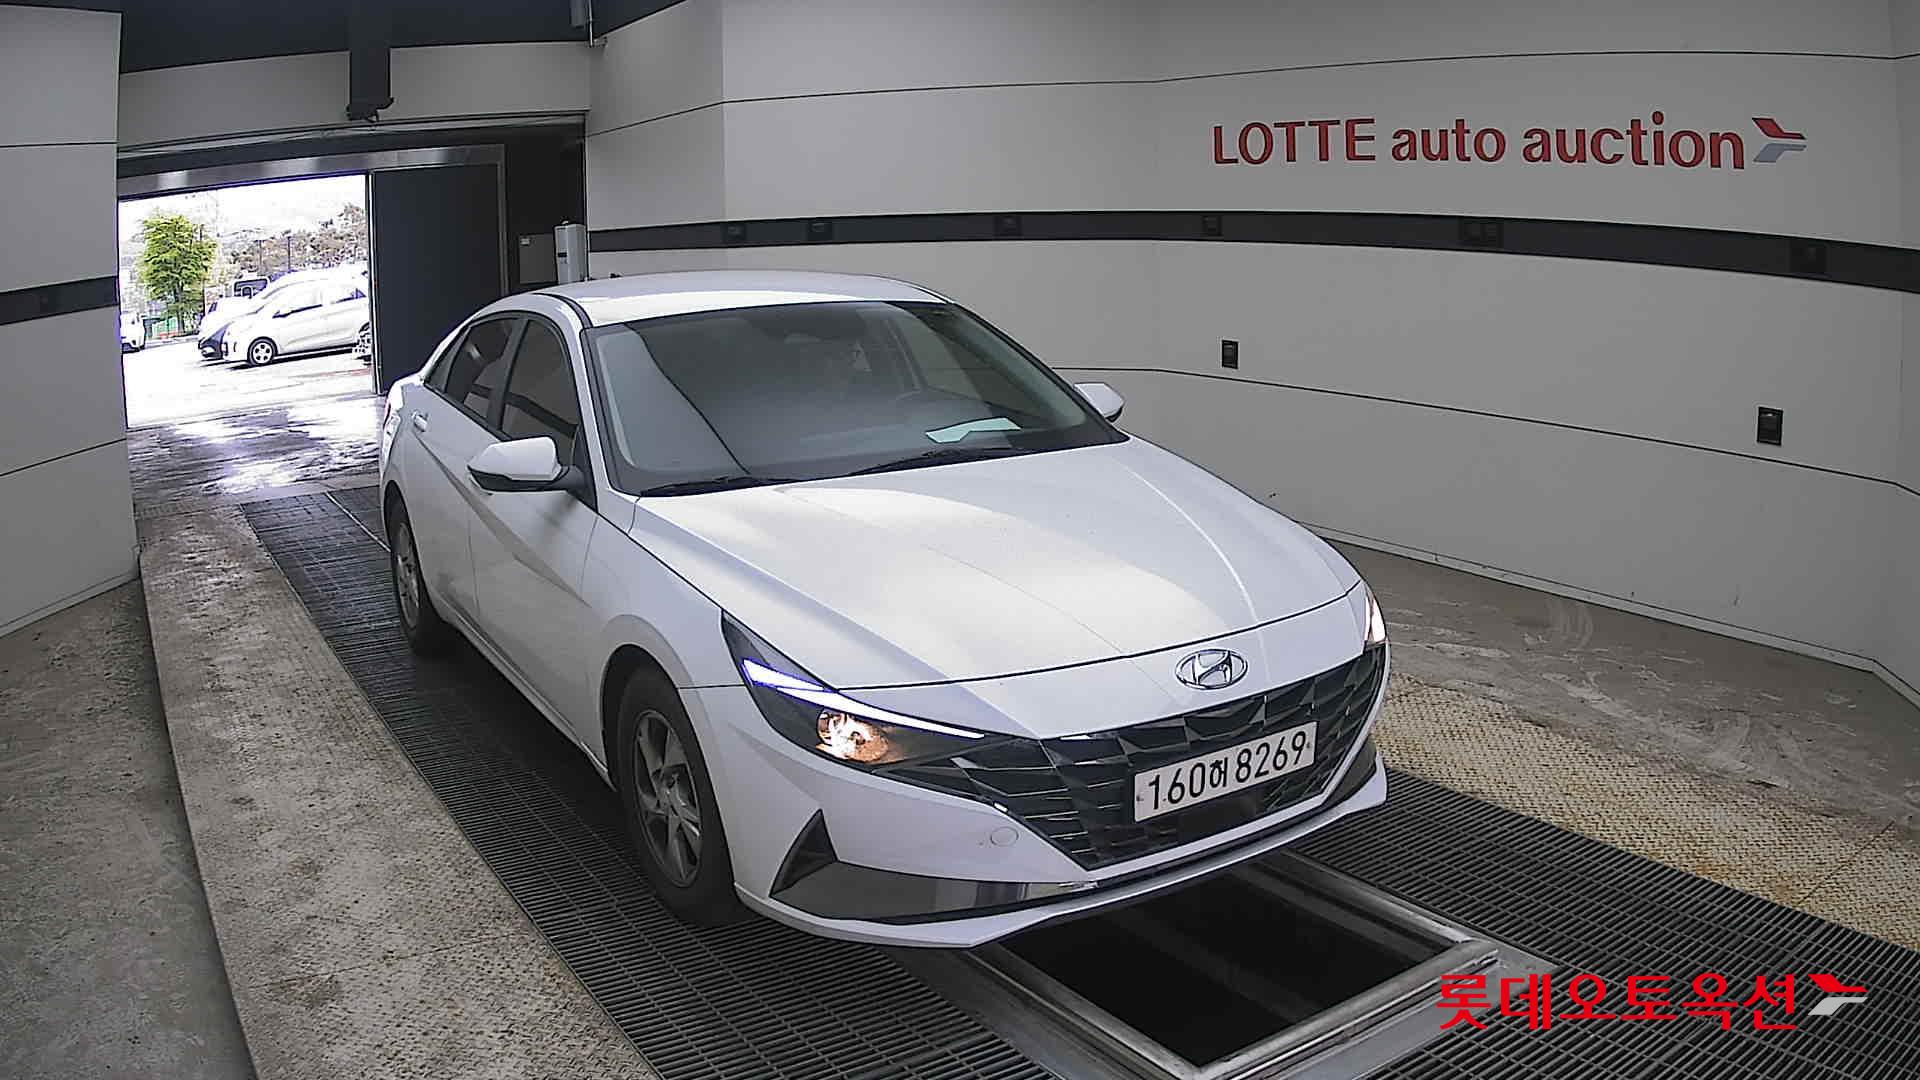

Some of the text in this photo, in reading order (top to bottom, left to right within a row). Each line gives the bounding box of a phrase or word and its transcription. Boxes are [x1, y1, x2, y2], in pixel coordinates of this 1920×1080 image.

[1213, 111, 1745, 169] LOTTE auto auction
